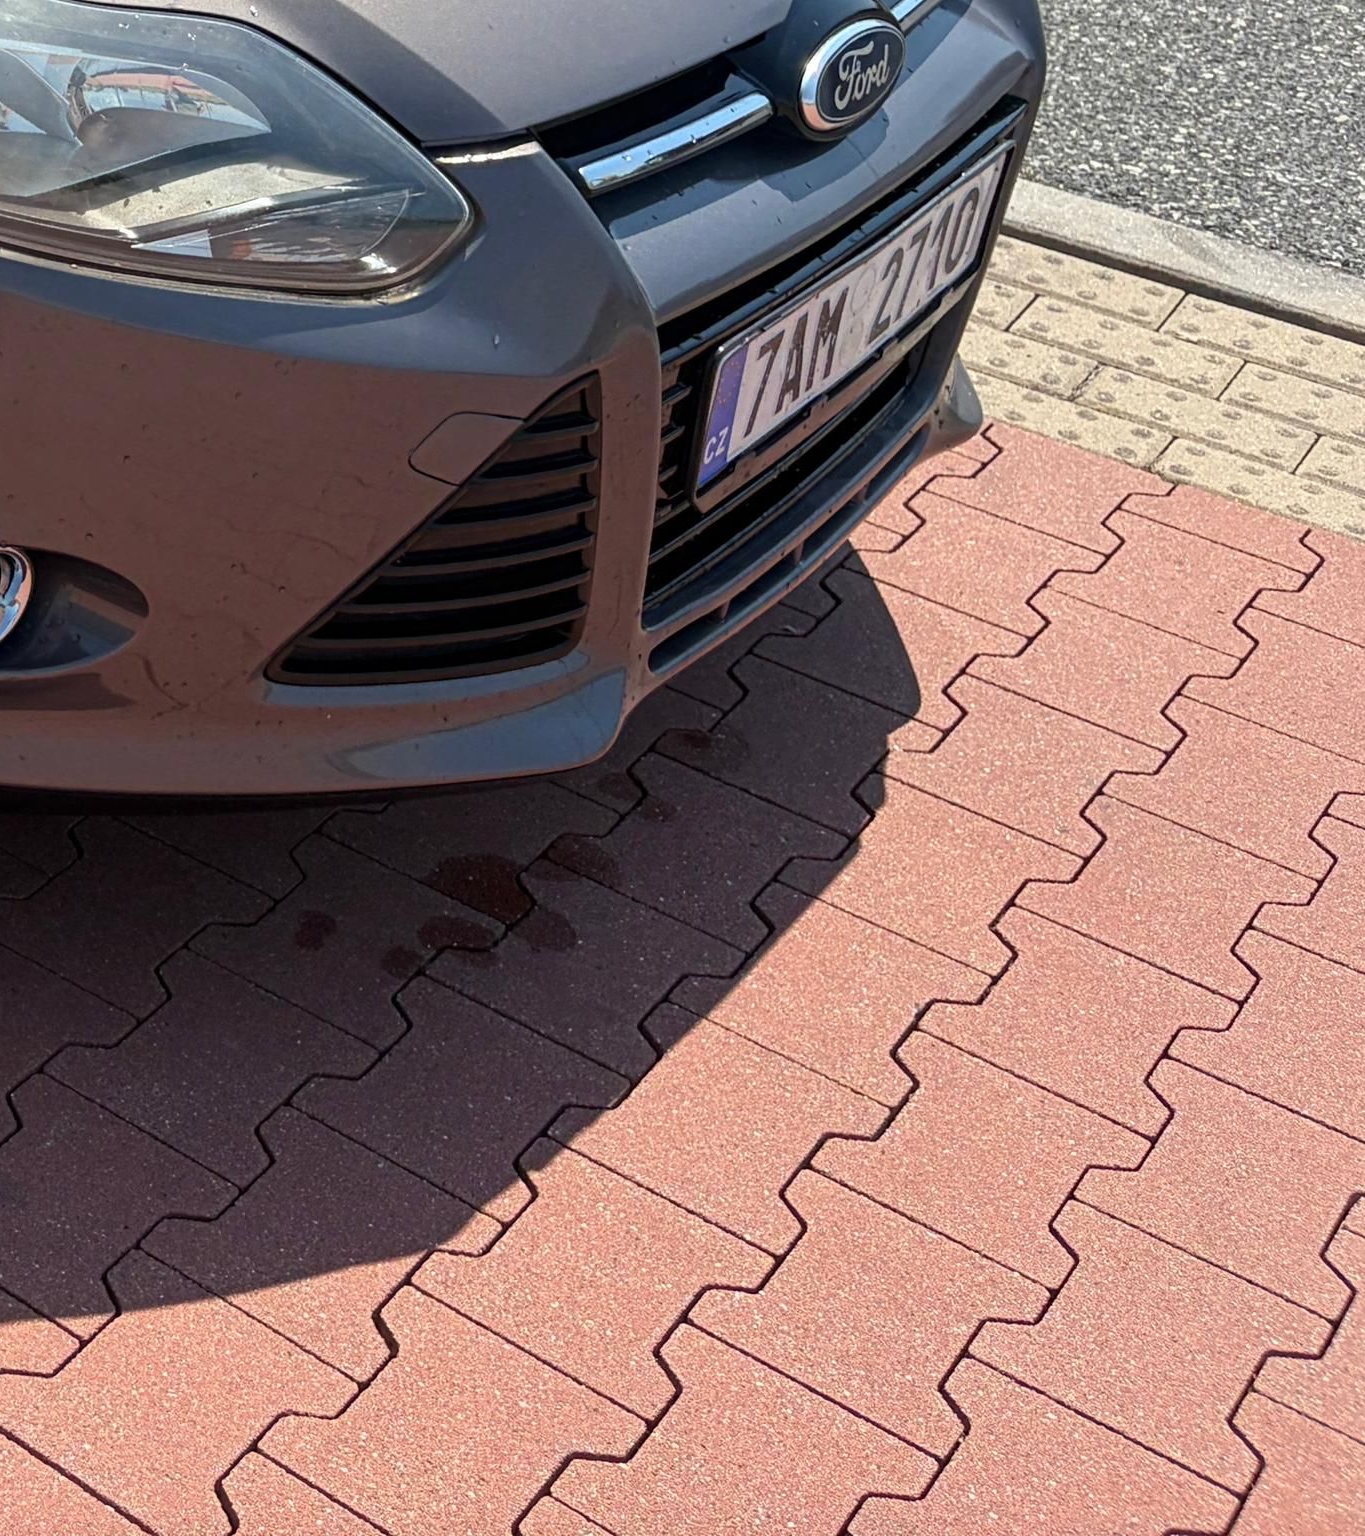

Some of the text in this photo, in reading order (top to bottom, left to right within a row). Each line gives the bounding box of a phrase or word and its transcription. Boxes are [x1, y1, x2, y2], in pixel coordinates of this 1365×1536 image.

[834, 40, 891, 111] Ford
[744, 186, 980, 437] 7AM 2710
[703, 427, 728, 464] CZ
